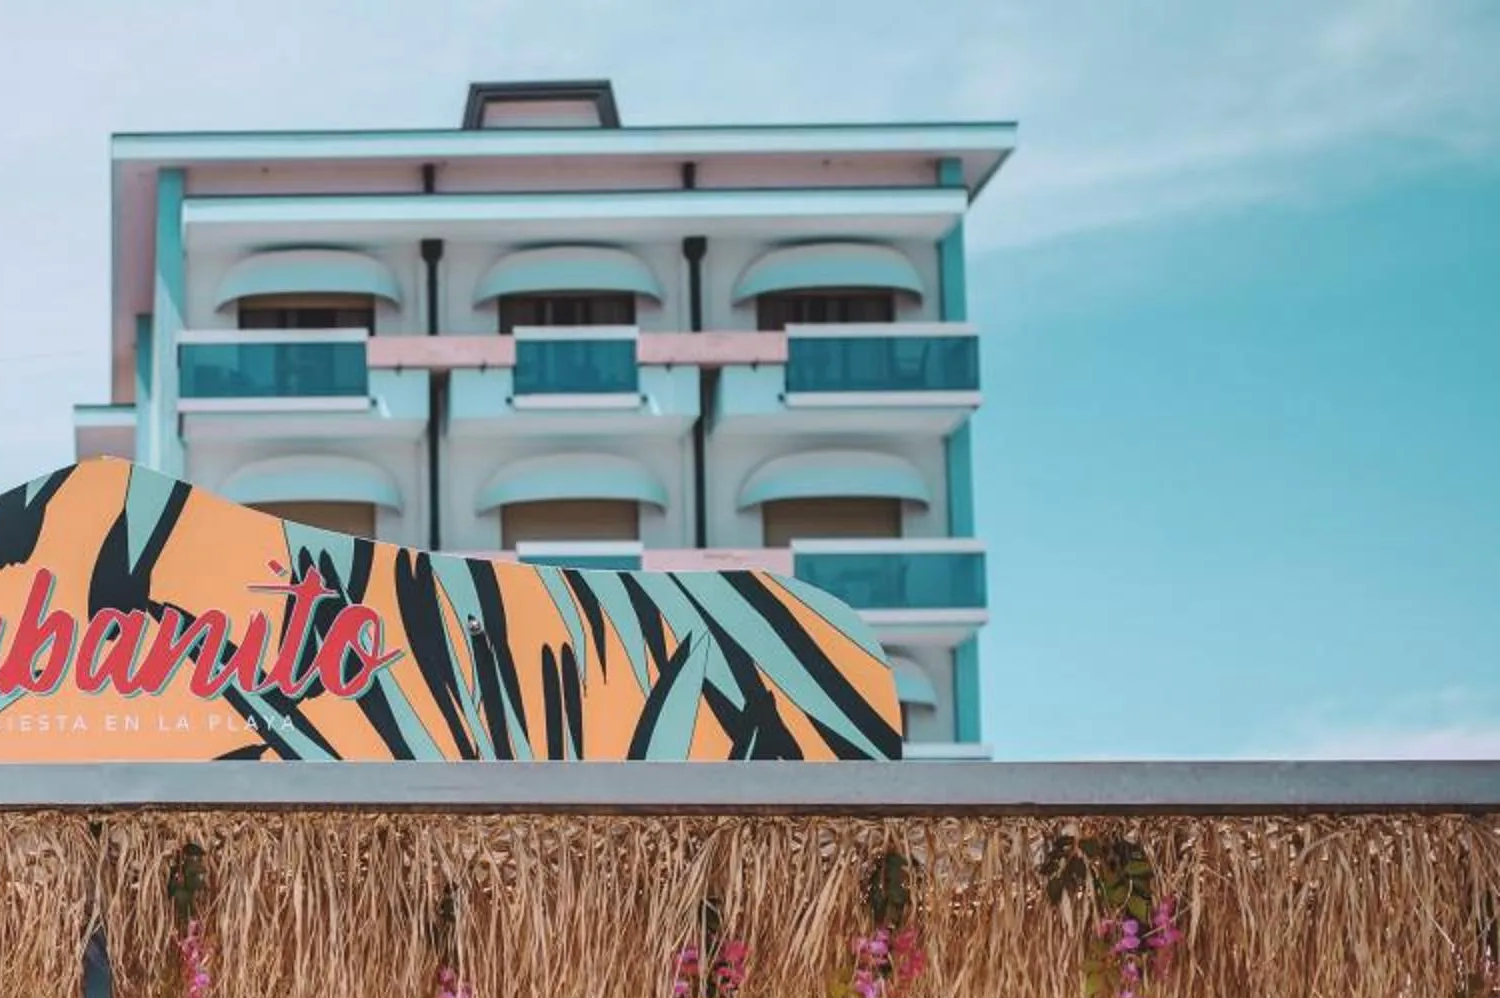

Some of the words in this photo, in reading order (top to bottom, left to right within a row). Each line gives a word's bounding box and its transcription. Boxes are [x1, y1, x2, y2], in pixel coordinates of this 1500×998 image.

[104, 714, 140, 732] EN
[158, 714, 190, 732] LA
[208, 714, 296, 732] PLAYA
